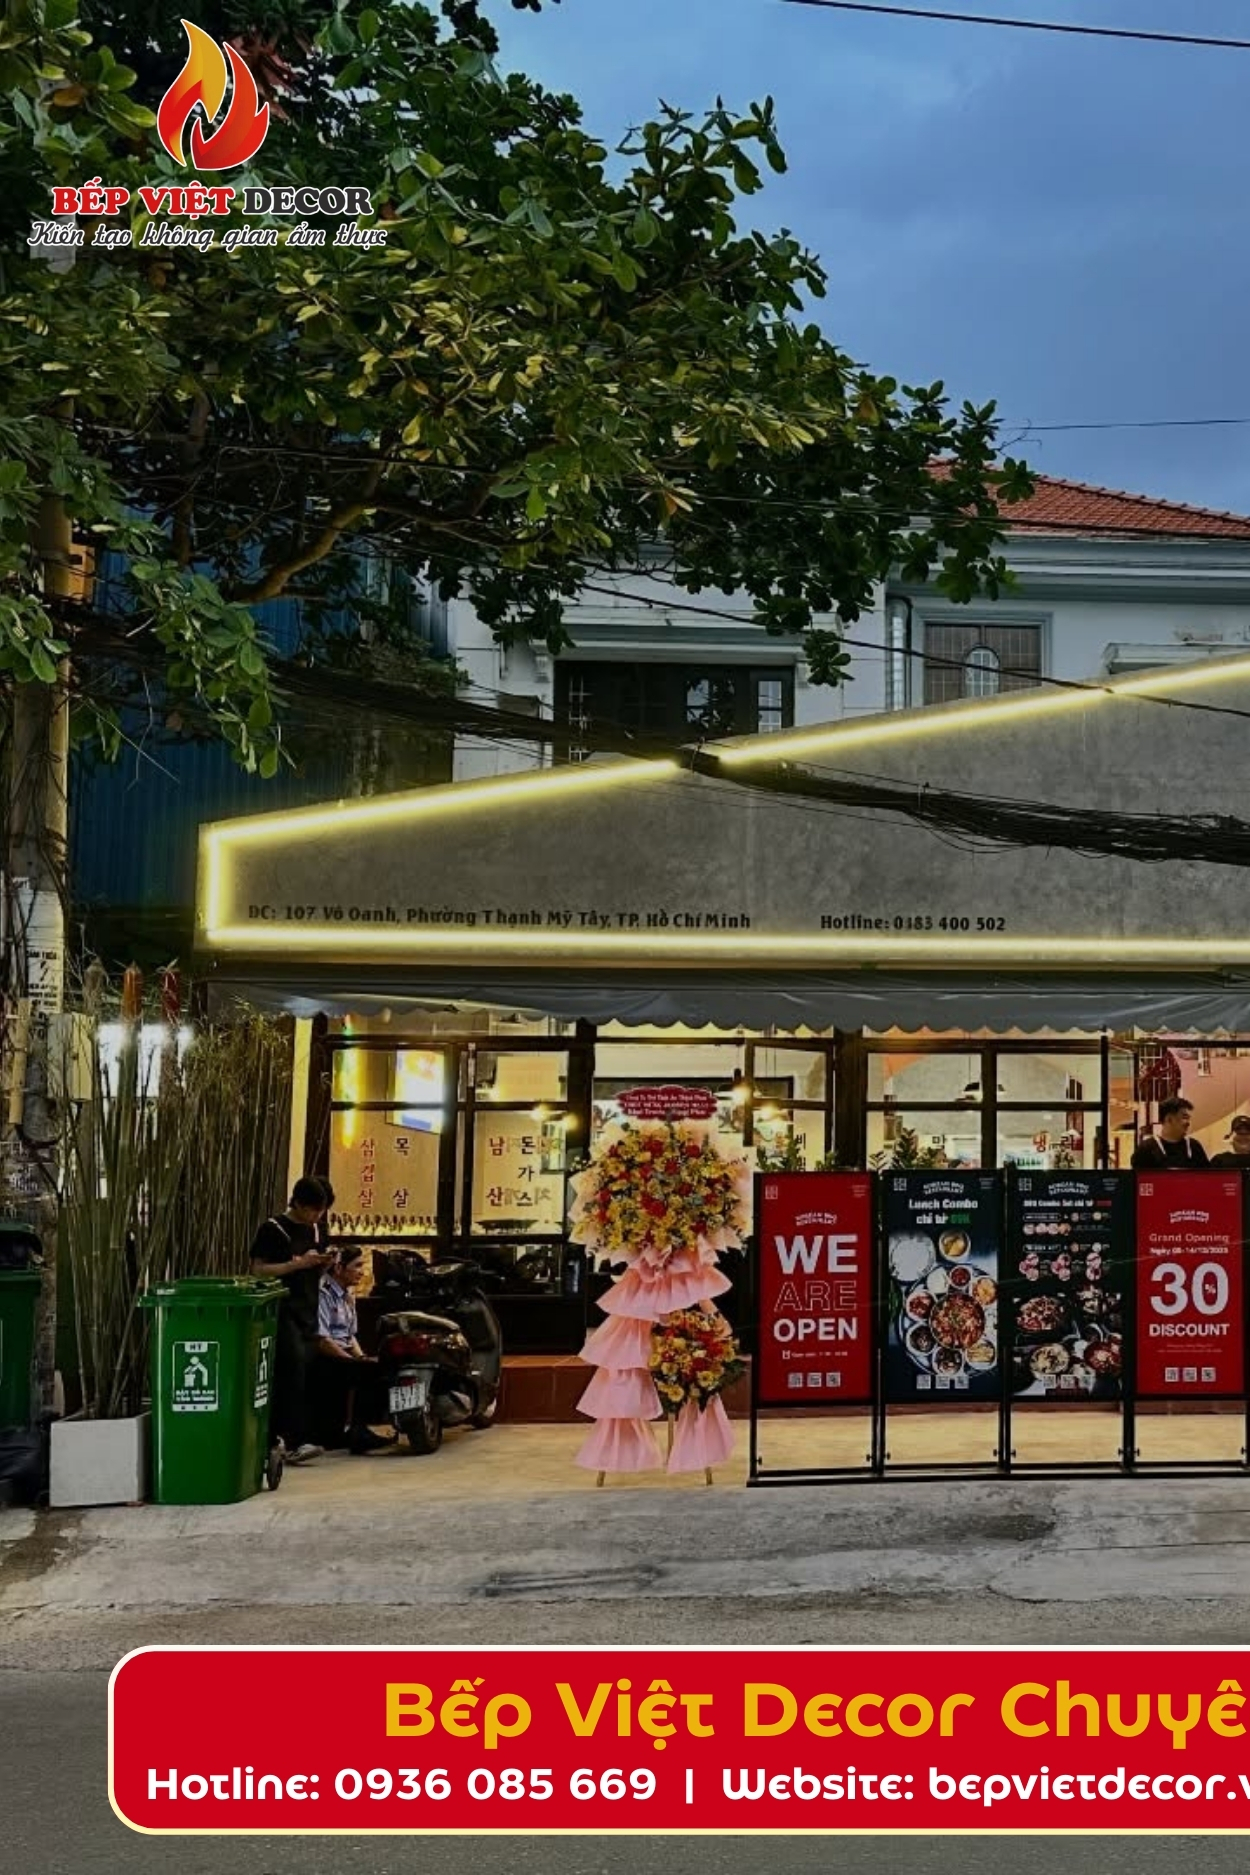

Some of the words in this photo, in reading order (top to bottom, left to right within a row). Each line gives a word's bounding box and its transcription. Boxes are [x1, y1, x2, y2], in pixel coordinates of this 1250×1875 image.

[285, 906, 316, 920] 107
[349, 906, 401, 924] Oanh,
[407, 907, 476, 928] Phường
[482, 908, 542, 929] Thạnh
[647, 911, 670, 928] Hồ
[673, 911, 702, 929] Chí
[704, 912, 750, 929] Minh
[821, 915, 889, 929] Hotline:
[939, 917, 970, 931] 400
[976, 918, 1006, 931] 502
[908, 1198, 940, 1210] Lunch
[942, 1198, 978, 1209] Combo
[1149, 1233, 1182, 1243] Grand
[1185, 1232, 1230, 1244] Opening
[774, 1234, 858, 1274] WE
[774, 1280, 857, 1312] ARE
[1150, 1261, 1230, 1317] 30
[773, 1317, 857, 1342] OPEN
[1148, 1323, 1230, 1338] DISCOUNT
